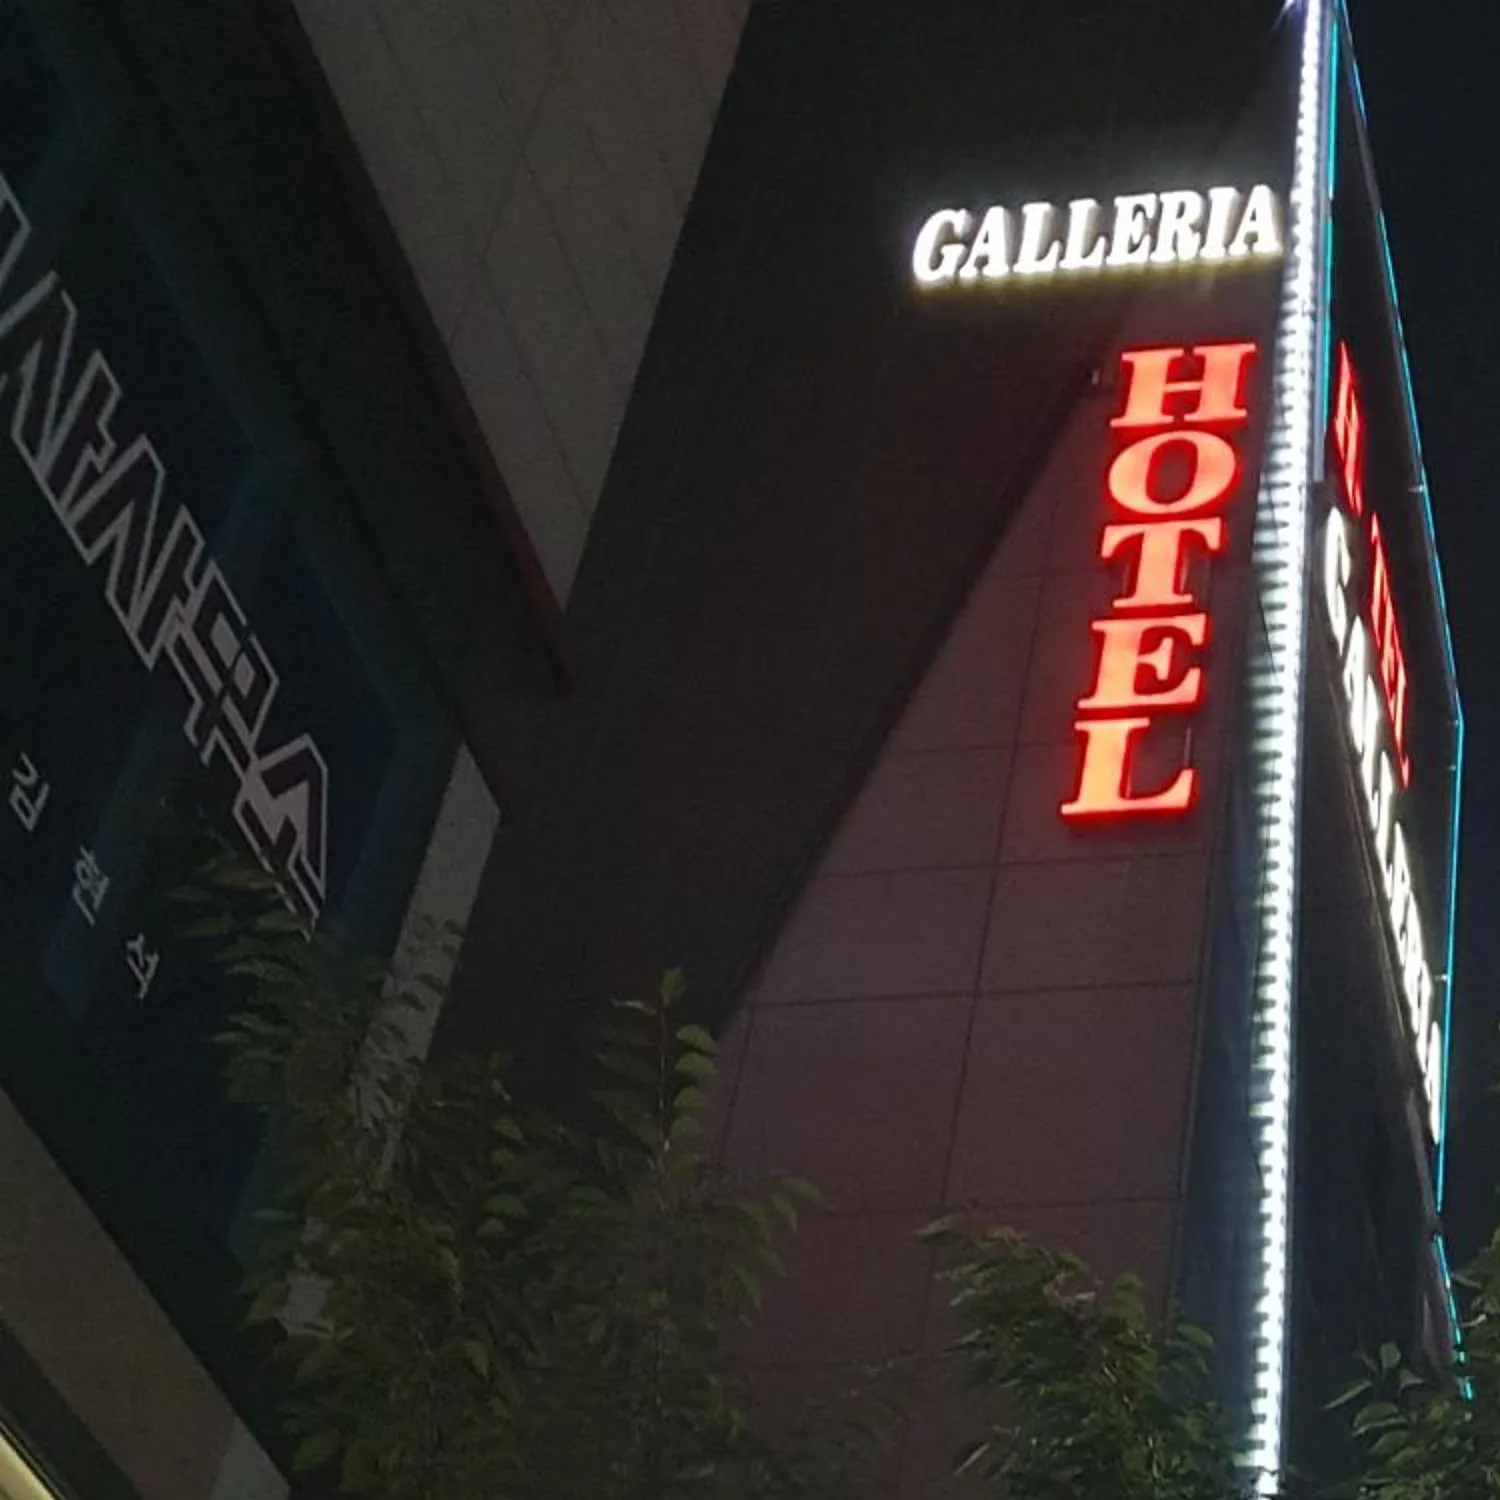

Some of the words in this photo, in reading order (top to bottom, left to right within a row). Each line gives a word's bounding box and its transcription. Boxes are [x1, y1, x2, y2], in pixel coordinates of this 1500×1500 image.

[911, 184, 1284, 283] GALLERIA
[0, 172, 329, 942] 사사무소
[1061, 342, 1257, 816] HOTEL
[1335, 340, 1408, 788] HTEL
